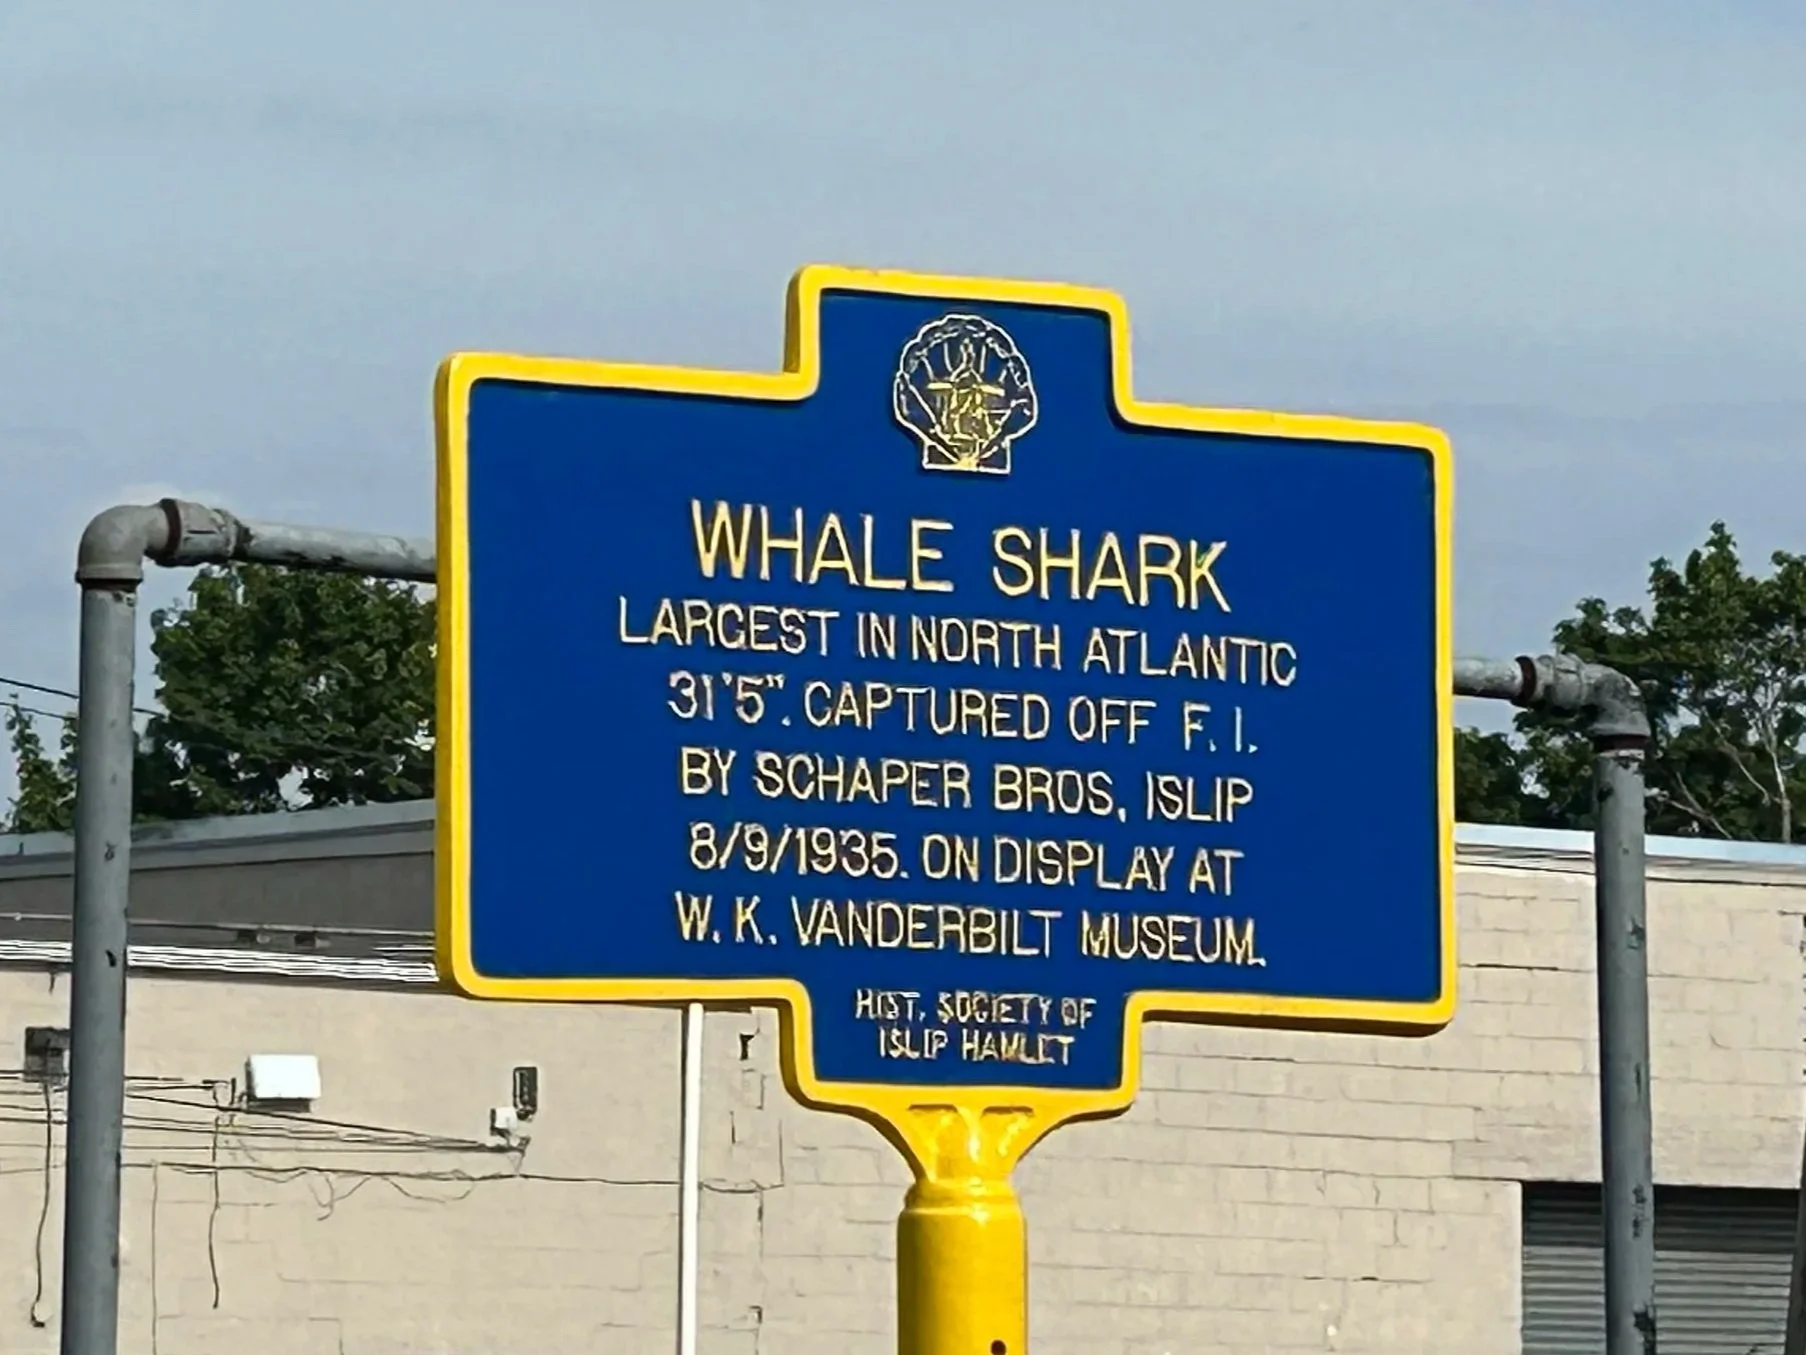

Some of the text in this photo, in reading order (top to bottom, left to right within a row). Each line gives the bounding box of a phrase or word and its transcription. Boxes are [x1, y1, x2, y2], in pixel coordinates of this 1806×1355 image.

[692, 499, 1230, 612] WHALE SHARK
[620, 596, 1296, 686] LARGEST IN NORTH ATLANTIC
[805, 681, 1049, 740] CAPTURED
[1069, 696, 1156, 743] OFF
[682, 747, 736, 795] BY
[753, 751, 971, 808] SCHAPER
[1147, 772, 1253, 822] ISLIP
[690, 822, 1243, 895] 8/9/1935. ON DISPLAY AT
[675, 891, 1266, 966] W. K. VANDERBILT MUSEUM.
[880, 1027, 1075, 1065] ISLIP HAMLET
[937, 991, 1052, 1024] SOCIETY
[1061, 998, 1096, 1028] OF
